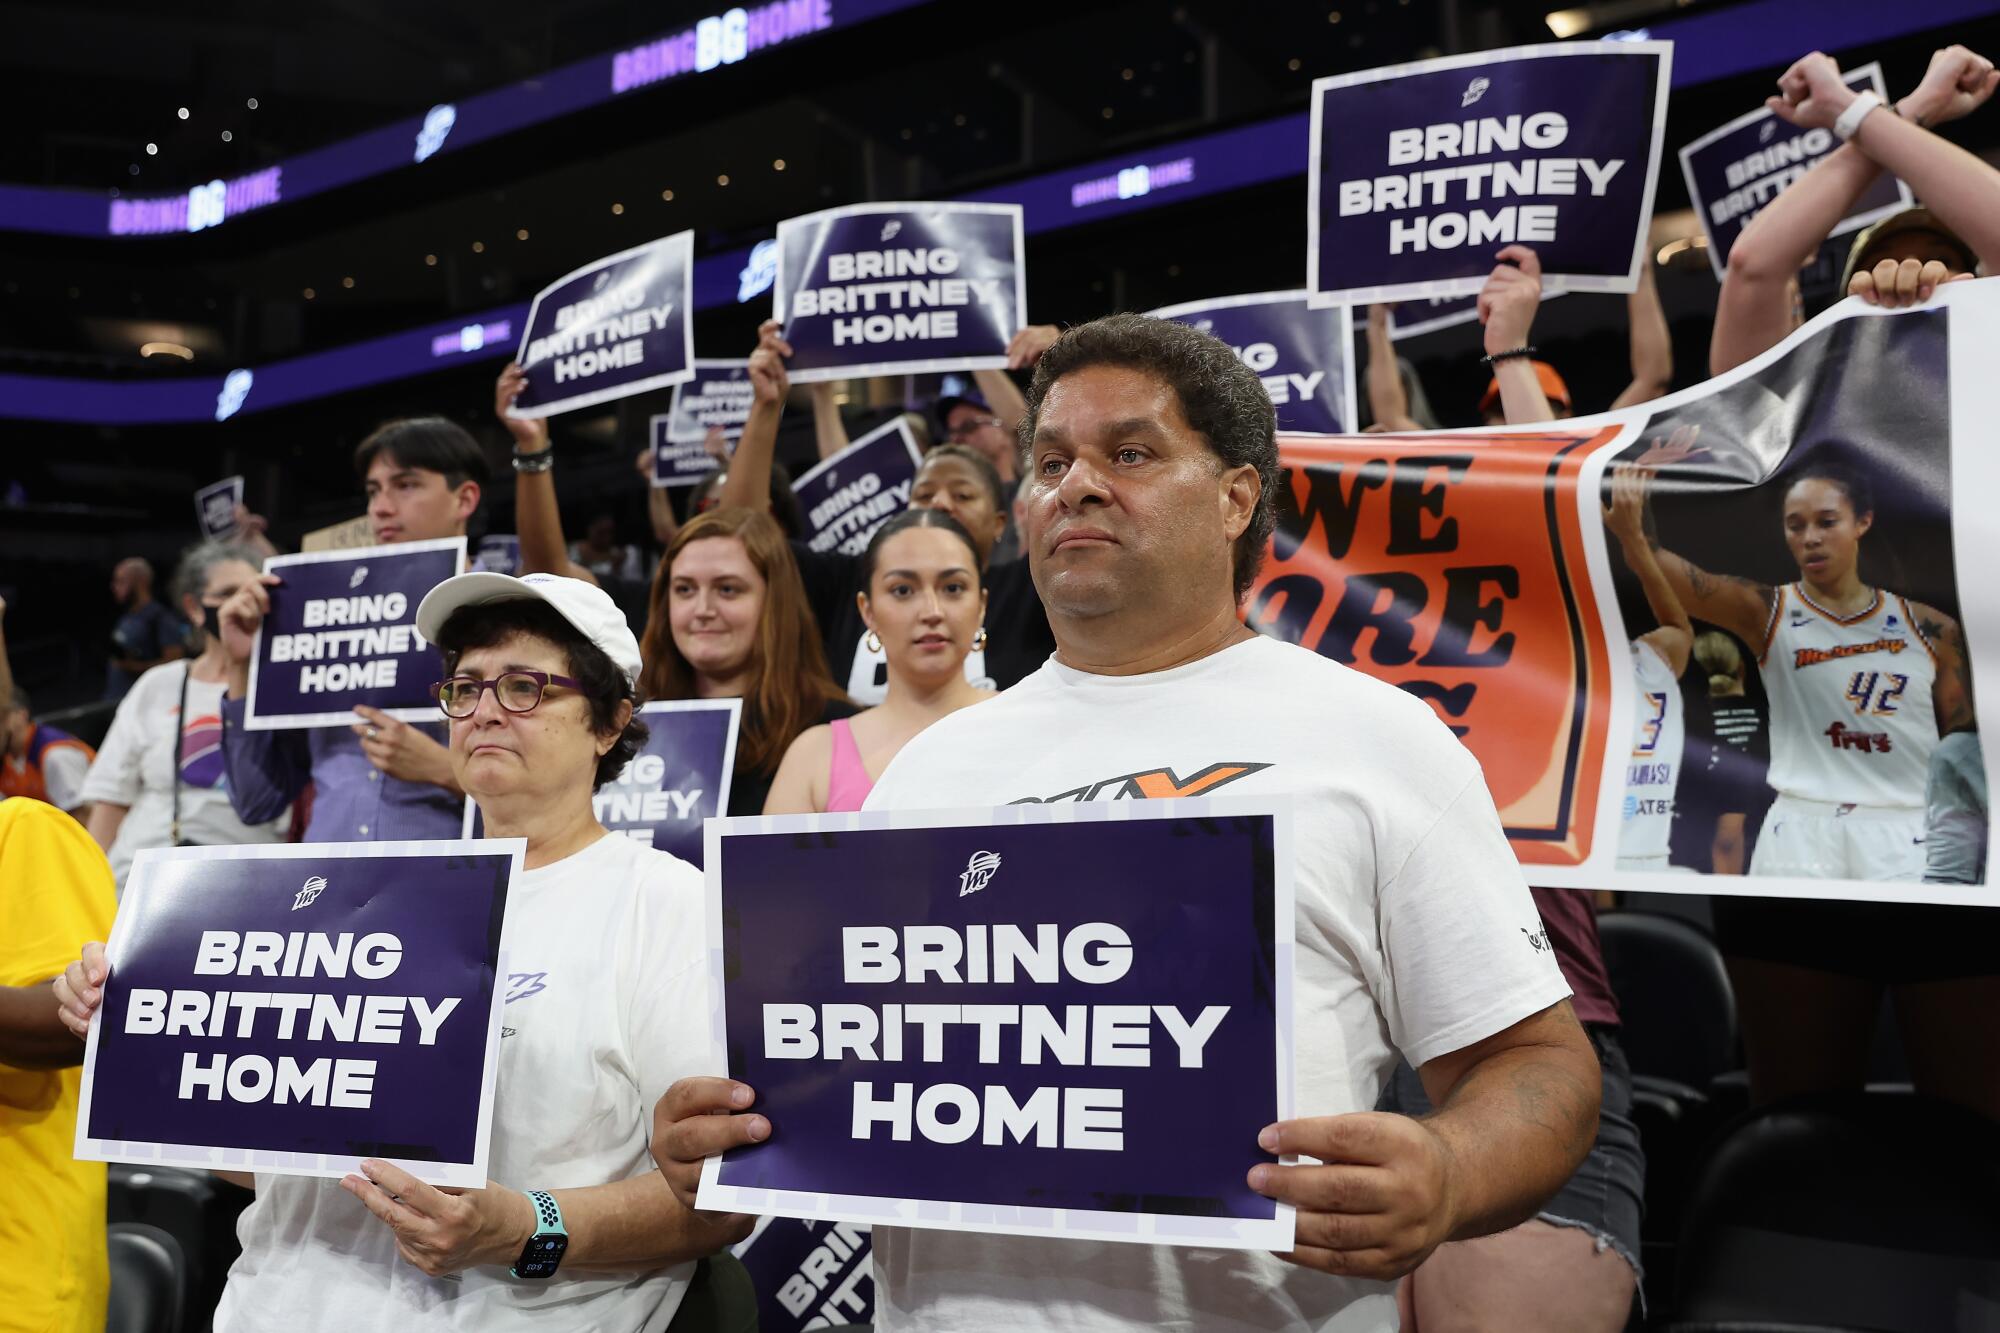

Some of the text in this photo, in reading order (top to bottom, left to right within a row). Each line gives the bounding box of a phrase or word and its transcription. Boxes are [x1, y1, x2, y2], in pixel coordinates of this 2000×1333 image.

[1388, 111, 1569, 166] BRING
[1724, 127, 1834, 190] BRING
[1339, 157, 1626, 217] BRITTNEY
[1709, 153, 1830, 226] BRITT
[1389, 204, 1559, 255] HOME
[828, 248, 960, 282] BRING
[792, 278, 1000, 318] BRITTNEY
[527, 302, 674, 364] BRITTNEY
[832, 310, 959, 346] HOME
[554, 337, 644, 384] HOME
[1272, 454, 1474, 560] WE
[303, 592, 408, 628] BRING
[1245, 564, 1520, 668] ARE
[270, 623, 429, 663] BRITTNEY
[299, 658, 399, 694] HOME
[1845, 671, 1910, 716] 42
[193, 930, 403, 981] BRING
[842, 922, 1134, 984] BRING
[124, 989, 462, 1046] BRITTNEY
[763, 1003, 1232, 1068] BRITTNEY
[178, 1052, 378, 1110] HOME
[851, 1081, 1124, 1151] HOME
[774, 1220, 873, 1319] BRIN
